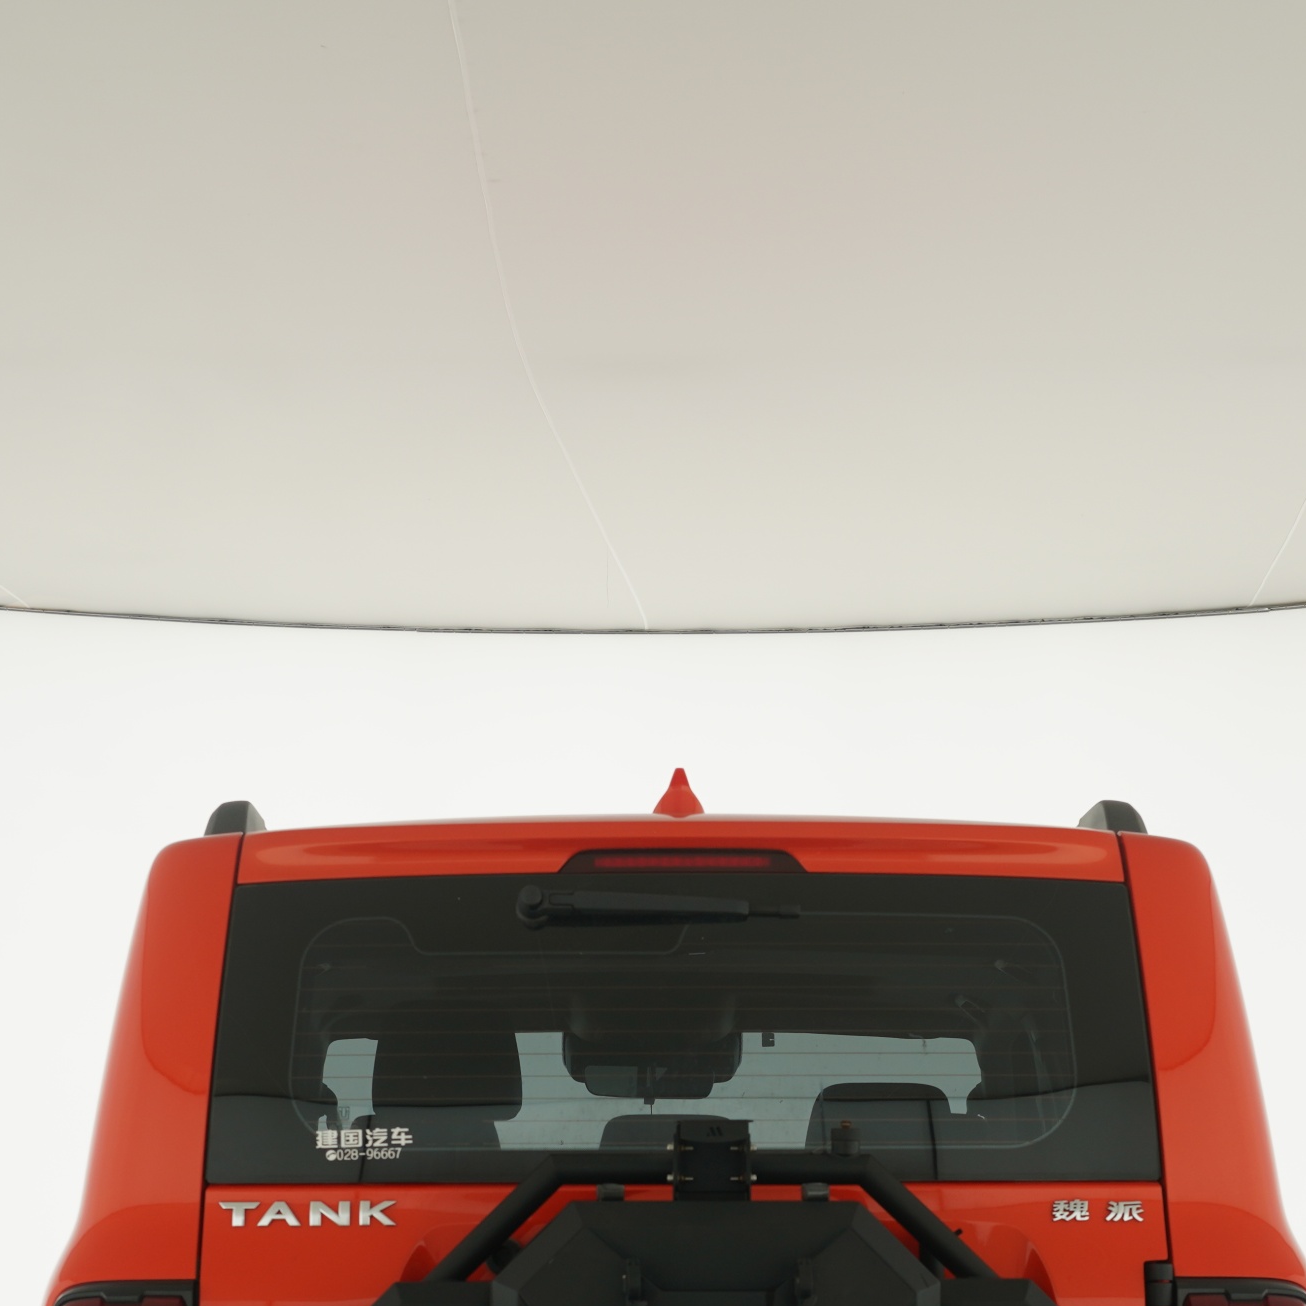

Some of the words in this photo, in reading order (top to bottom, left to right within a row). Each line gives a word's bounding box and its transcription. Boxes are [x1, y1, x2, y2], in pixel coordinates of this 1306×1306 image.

[316, 1126, 413, 1149] 建国汽车
[336, 1147, 402, 1160] 028-96667
[219, 1200, 397, 1227] TANK
[1052, 1199, 1144, 1222] 魏派
